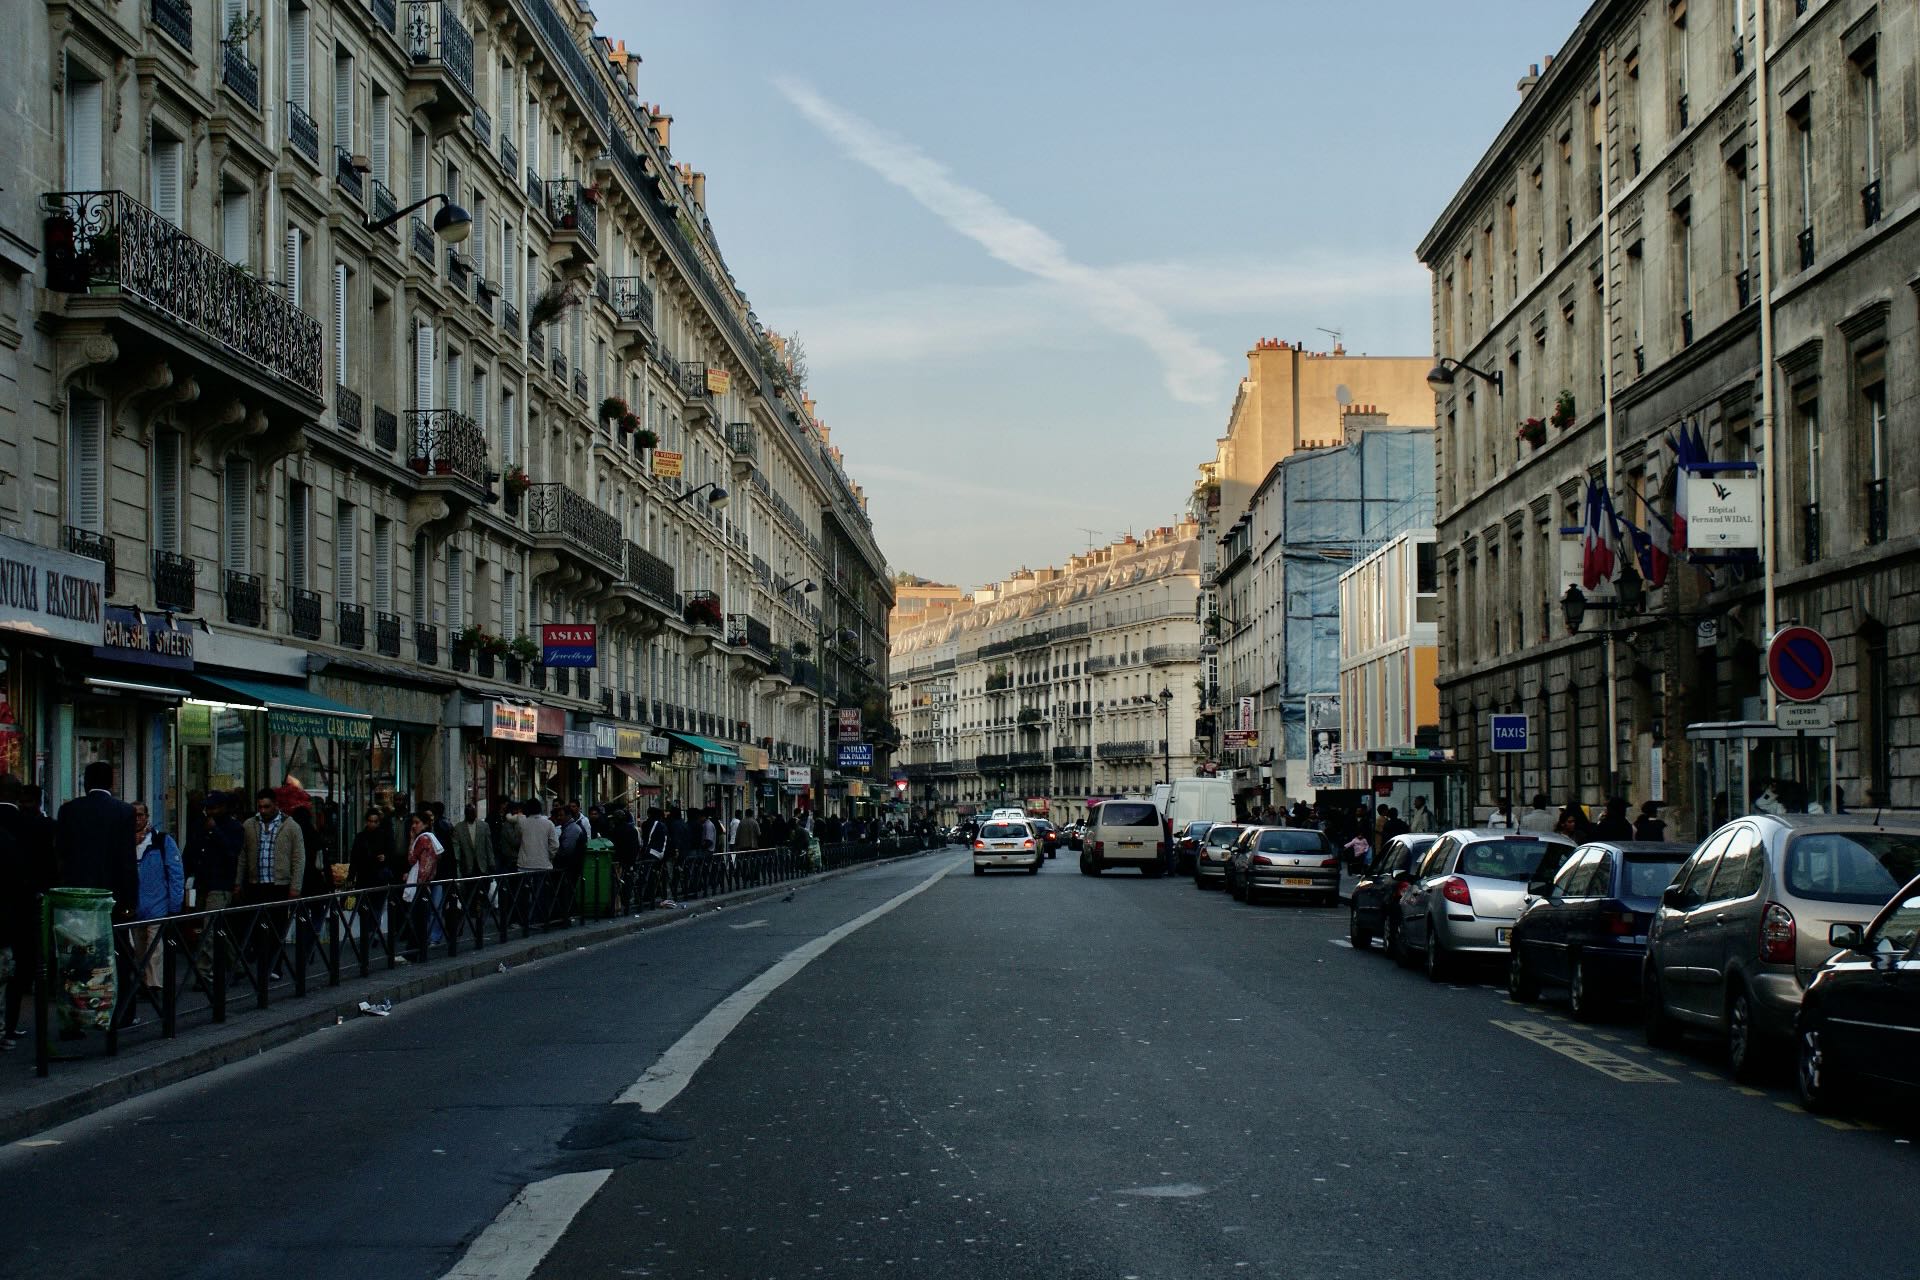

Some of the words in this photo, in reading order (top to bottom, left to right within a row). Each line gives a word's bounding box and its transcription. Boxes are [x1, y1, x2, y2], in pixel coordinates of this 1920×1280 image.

[1708, 505, 1736, 514] Hôpital
[1692, 515, 1723, 523] Fernand
[1724, 515, 1753, 523] WIDAL
[47, 570, 101, 624] FASHION
[548, 631, 593, 641] ASIAN
[155, 629, 193, 657] SWEETS
[922, 685, 950, 693] NATIONAL
[932, 693, 940, 739] HOTEL
[1058, 700, 1066, 729] HOTEL
[327, 717, 345, 736] CASH
[349, 720, 371, 738] CARRY
[1496, 728, 1526, 738] TAXIS
[843, 745, 867, 753] INDIAN
